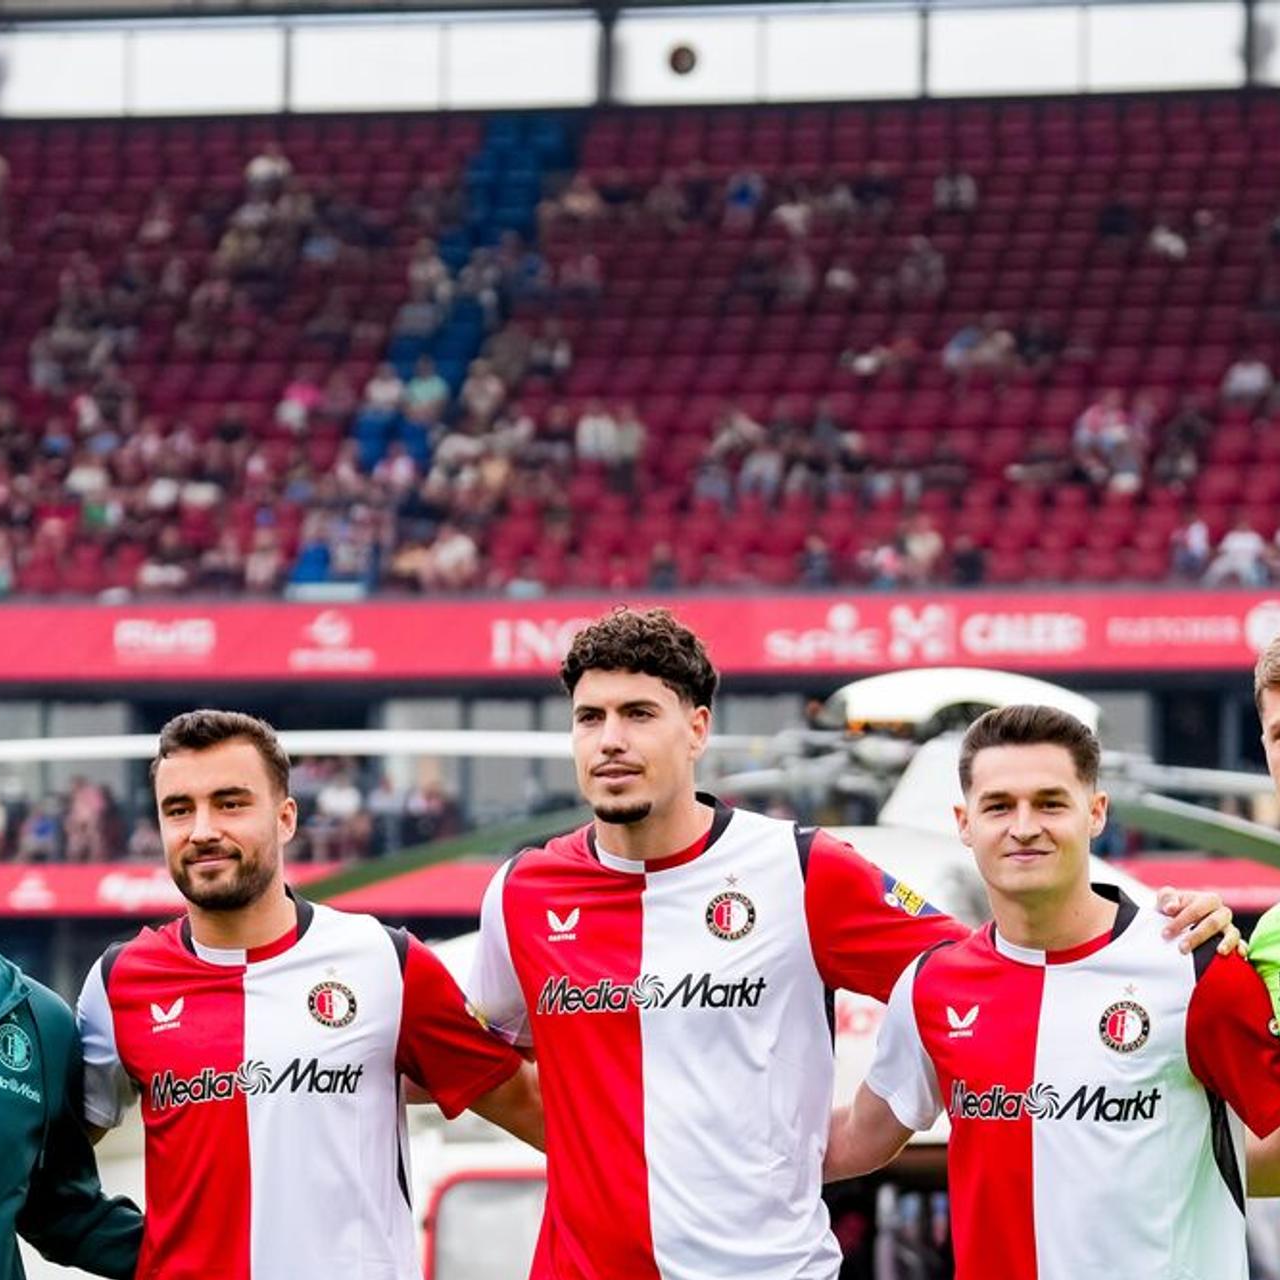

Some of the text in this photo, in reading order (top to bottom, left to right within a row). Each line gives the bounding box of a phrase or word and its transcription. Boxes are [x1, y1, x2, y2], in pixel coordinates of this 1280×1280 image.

[537, 973, 766, 1014] Media Markt
[151, 1058, 363, 1111] Media Markt
[1056, 1085, 1161, 1121] Markt
